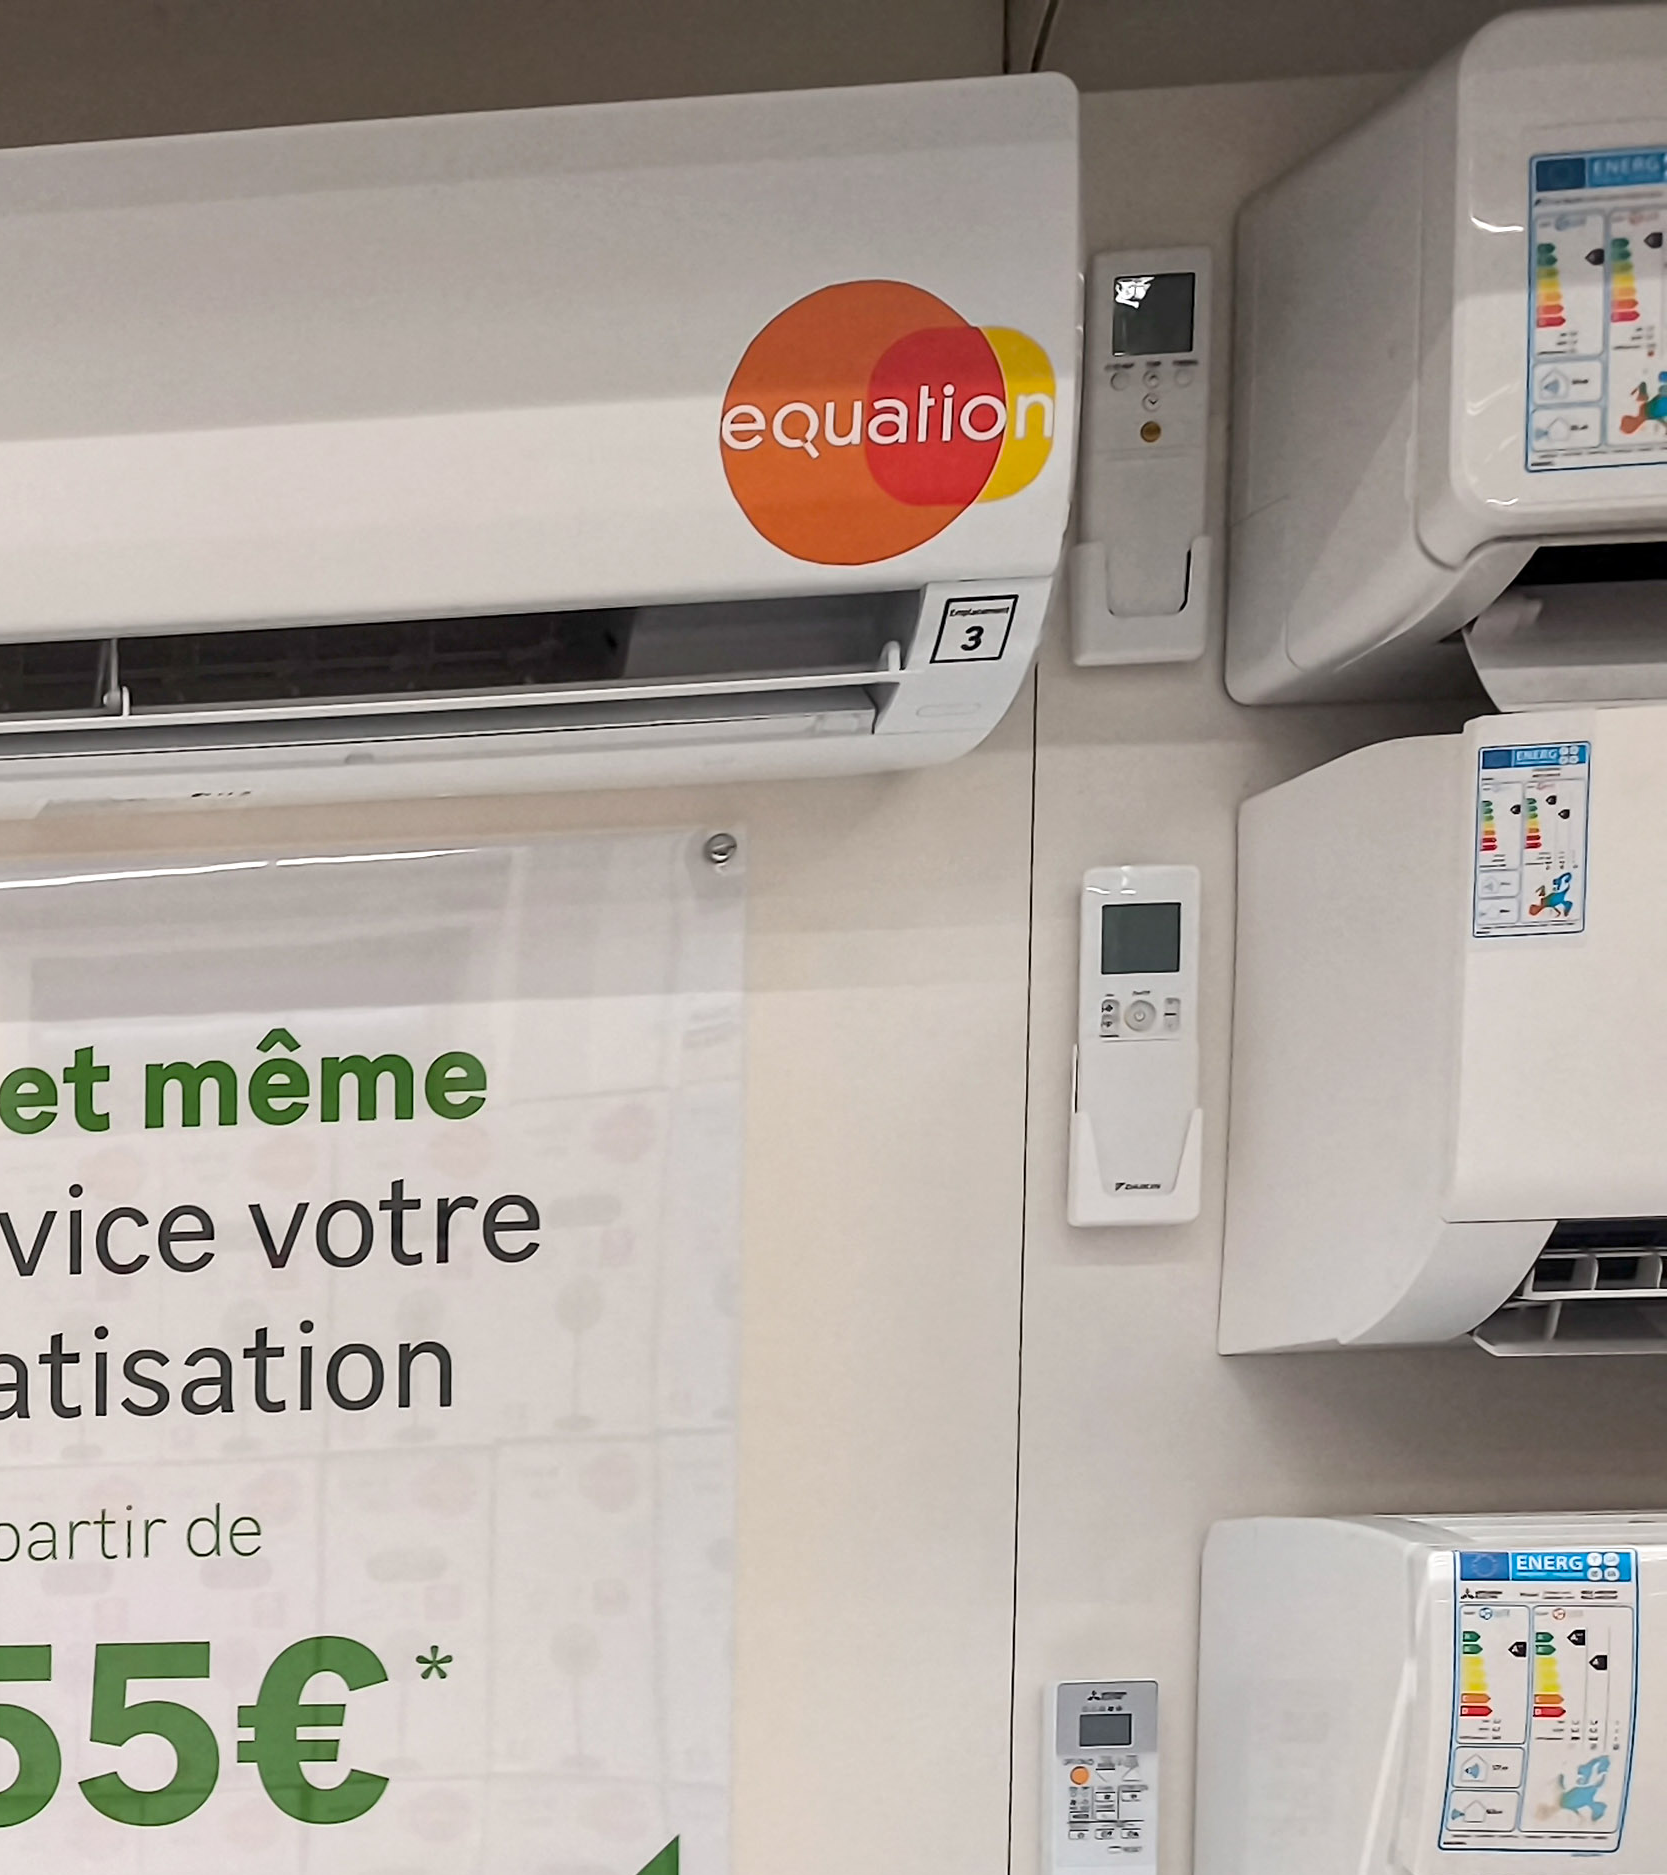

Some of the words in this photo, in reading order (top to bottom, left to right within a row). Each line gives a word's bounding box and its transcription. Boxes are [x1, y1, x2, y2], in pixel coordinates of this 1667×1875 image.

[720, 384, 1056, 460] equation
[961, 626, 983, 651] 3
[145, 1027, 486, 1130] même
[249, 1178, 540, 1269] votre
[186, 1502, 263, 1559] de
[1517, 1555, 1583, 1571] ENERG
